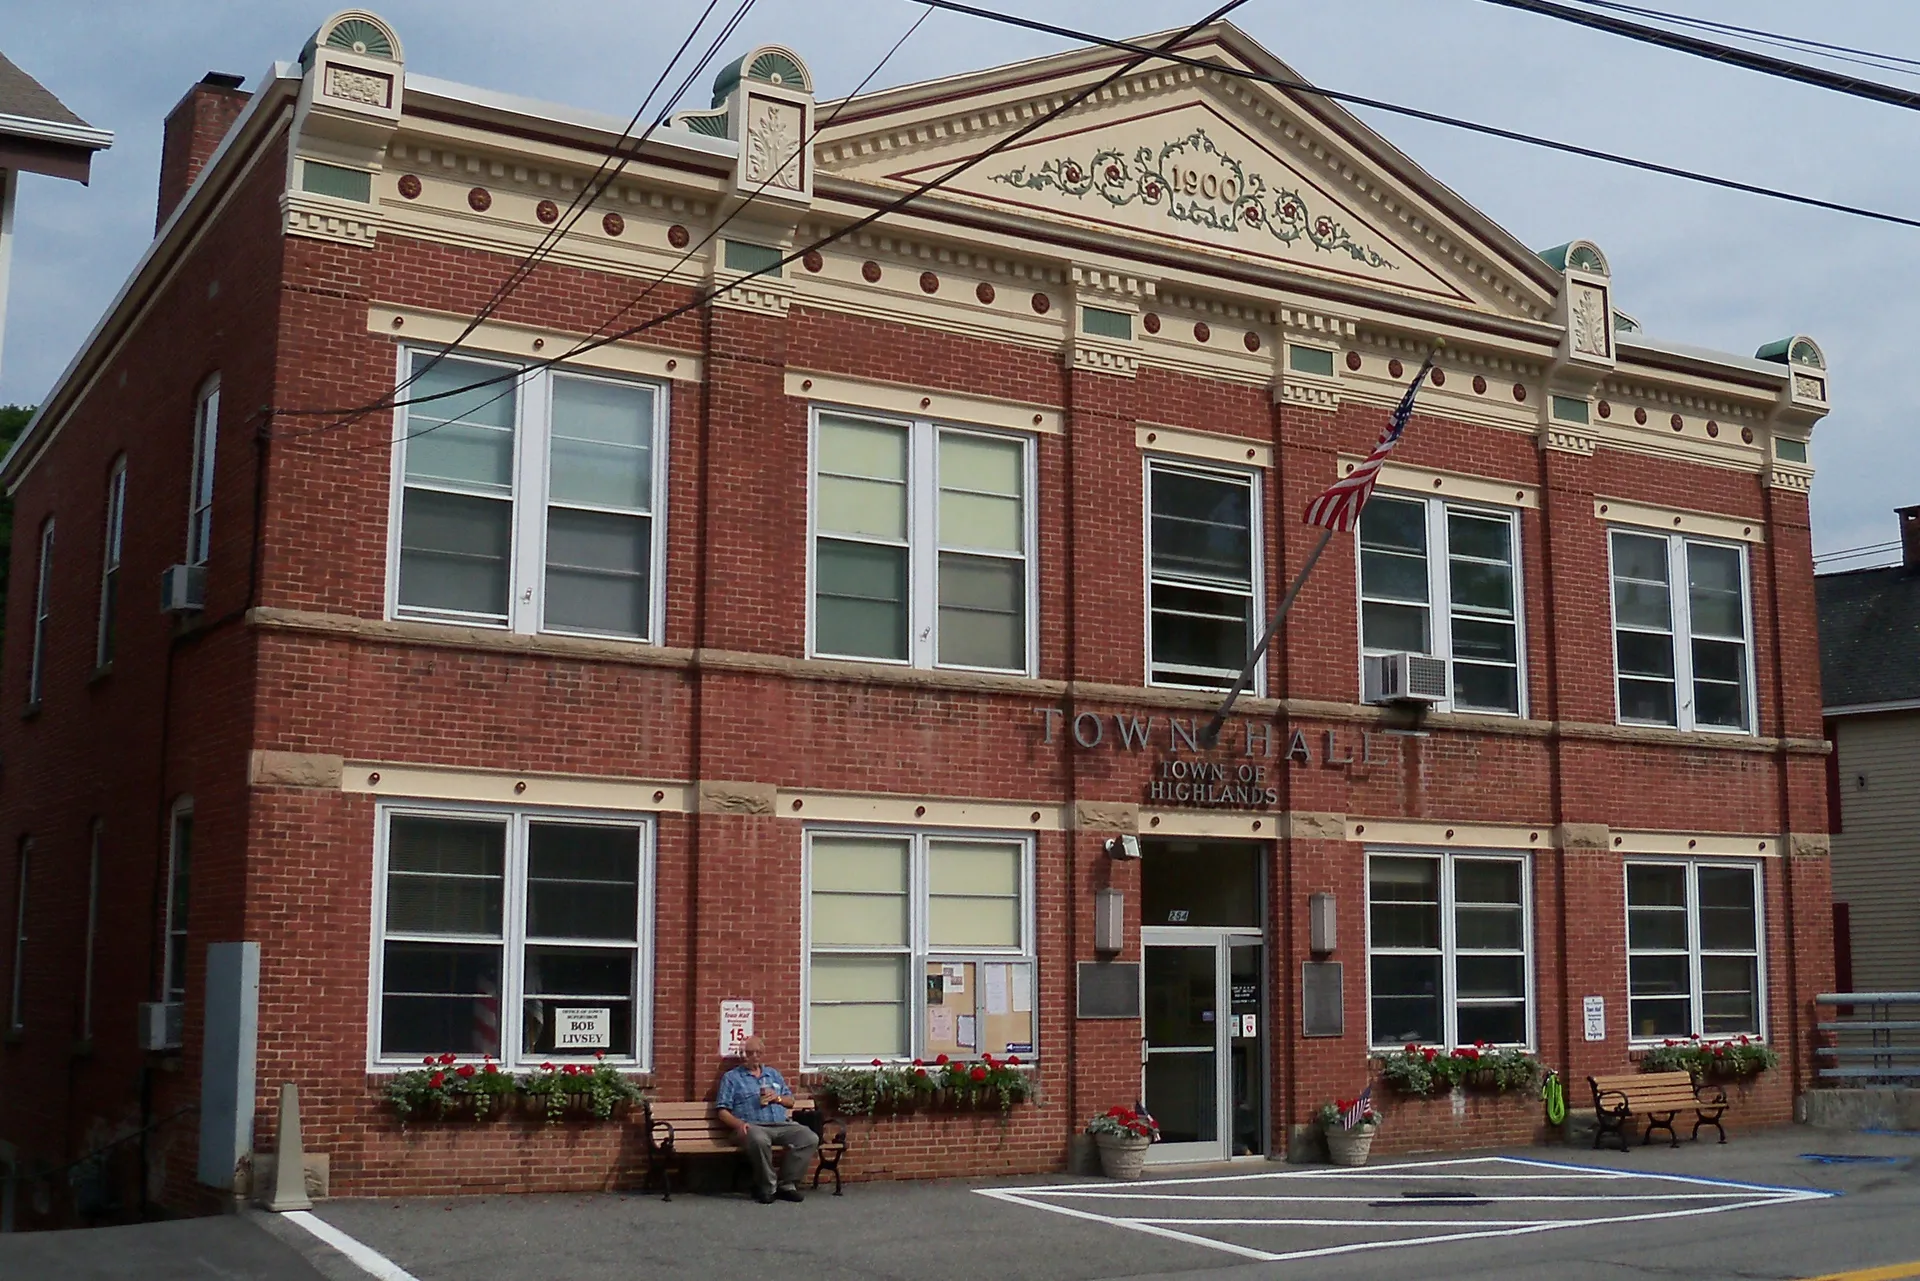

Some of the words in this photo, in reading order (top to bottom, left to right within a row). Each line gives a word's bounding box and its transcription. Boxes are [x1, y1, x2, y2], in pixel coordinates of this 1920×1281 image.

[1172, 164, 1236, 205] 1900
[1033, 707, 1199, 753] TOWN
[1244, 719, 1389, 767] HALL
[1161, 760, 1224, 782] TOWN
[1238, 764, 1266, 783] OF
[1150, 781, 1278, 805] HIGHLANDS
[571, 1021, 595, 1031] BOB
[730, 1028, 744, 1041] 15
[562, 1033, 604, 1043] LIVSEY
